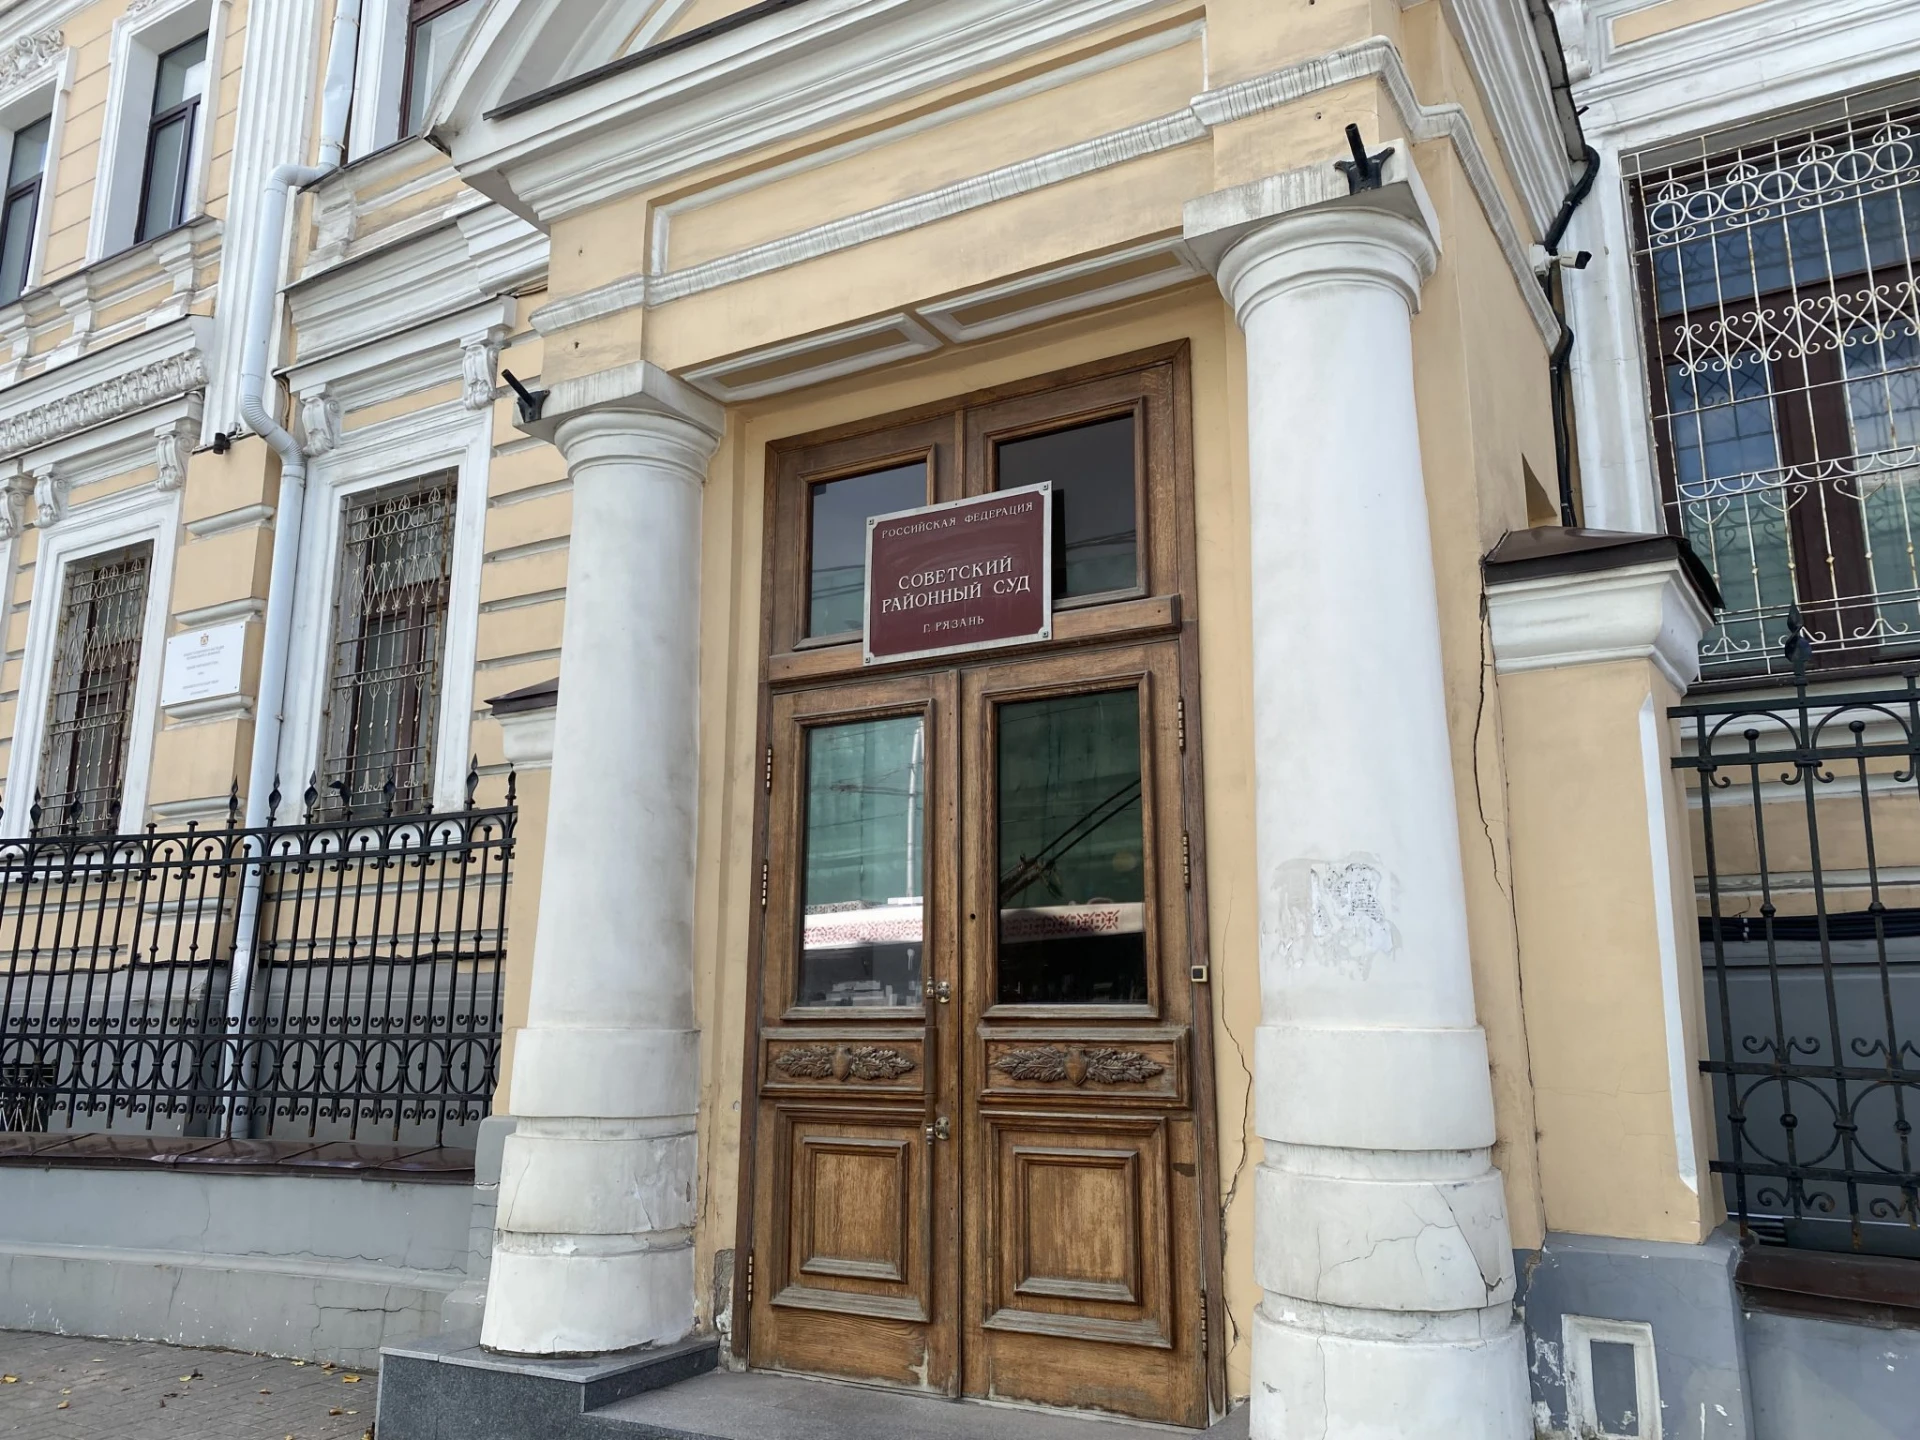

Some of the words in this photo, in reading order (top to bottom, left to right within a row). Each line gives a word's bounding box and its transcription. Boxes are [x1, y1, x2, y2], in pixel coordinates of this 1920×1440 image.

[882, 518, 956, 538] РОССИЙСКАЯ
[965, 502, 1033, 523] ФЕДЕРАЦИЯ
[899, 556, 1012, 589] СОВЕТСКИЙ
[882, 582, 982, 613] РАЙОННЫЙ
[994, 576, 1030, 594] СУД
[936, 616, 984, 631] РЯЗАНЬ
